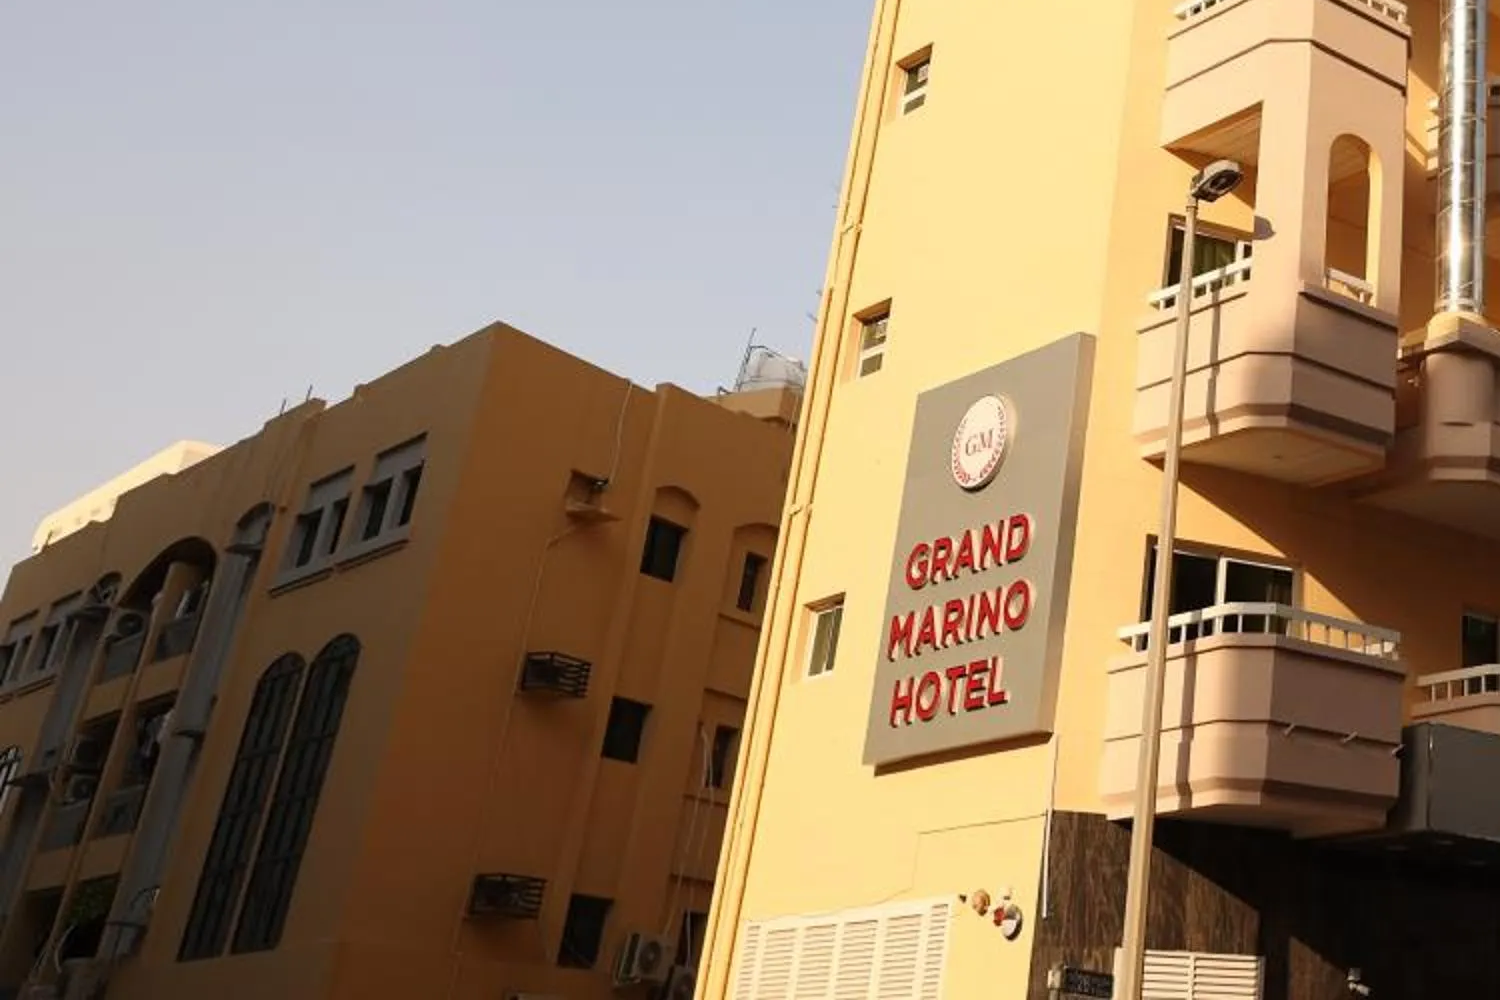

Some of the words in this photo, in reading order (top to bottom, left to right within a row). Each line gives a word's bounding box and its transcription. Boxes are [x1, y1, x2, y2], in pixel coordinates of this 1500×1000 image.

[965, 427, 995, 457] GM
[904, 513, 1031, 591] GRAND
[887, 579, 1033, 661] MARINO
[889, 655, 1008, 728] HOTEL
